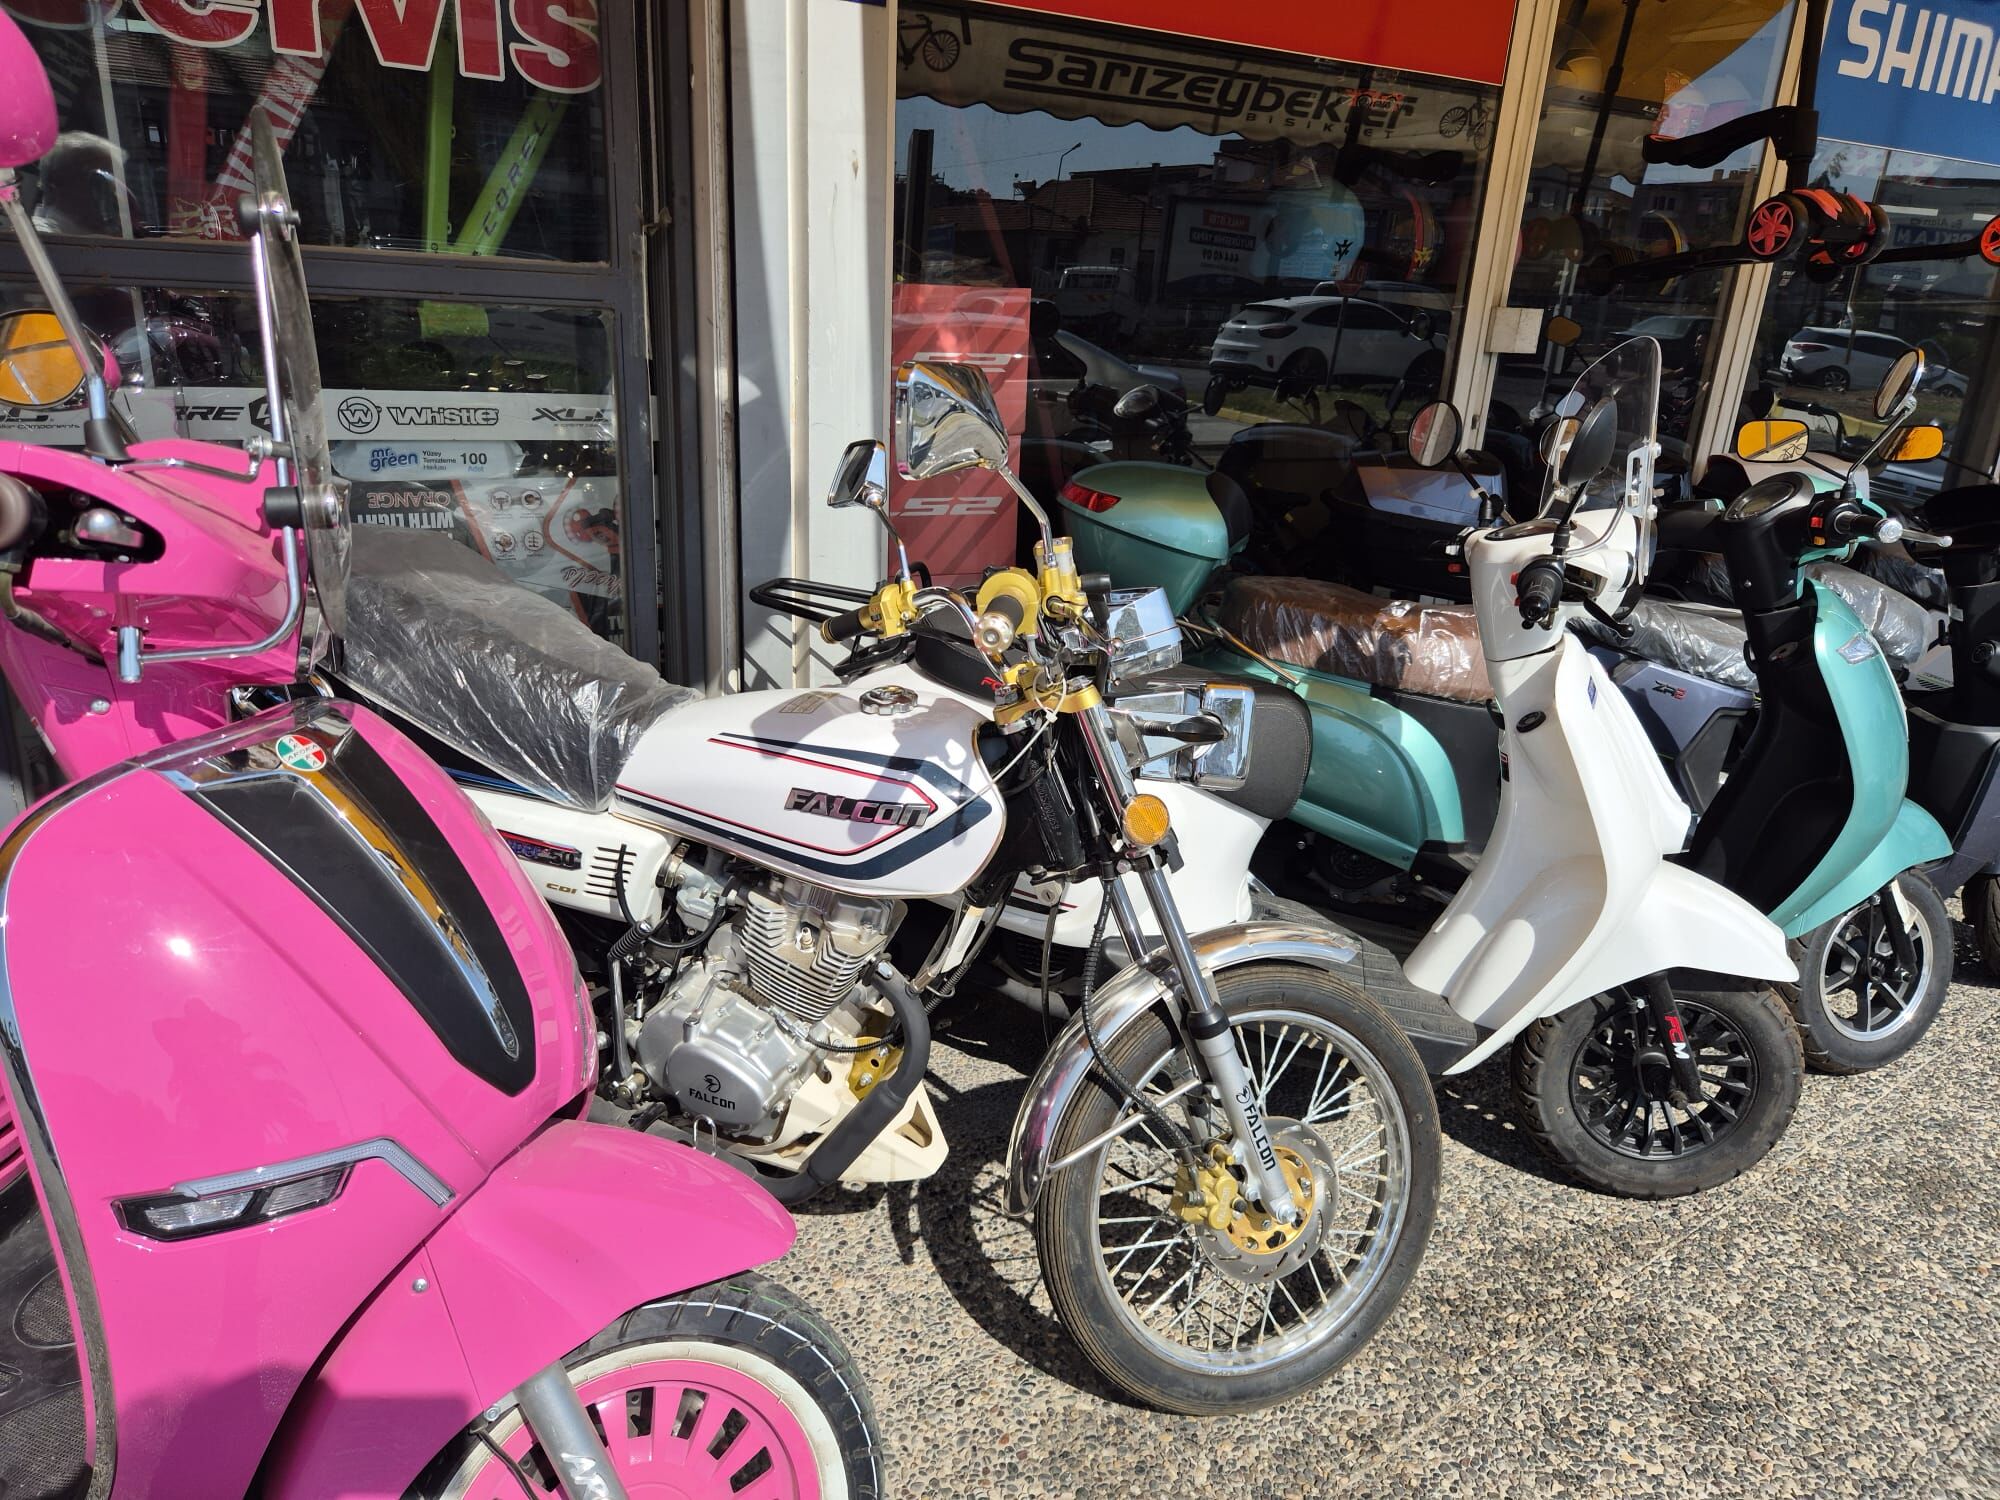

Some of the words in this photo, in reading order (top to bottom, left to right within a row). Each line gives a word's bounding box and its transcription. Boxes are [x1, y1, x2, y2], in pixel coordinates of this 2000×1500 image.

[386, 406, 500, 425] Whistle
[369, 453, 419, 473] green
[459, 452, 488, 465] 100
[366, 491, 451, 509] ORANGE
[408, 512, 455, 529] WITH
[784, 787, 931, 828] FALCON
[545, 882, 577, 895] CDI
[1664, 1015, 1690, 1059] FCM
[689, 1087, 736, 1111] FALCON
[1243, 1103, 1277, 1172] FALCON
[560, 1452, 612, 1500] AR
